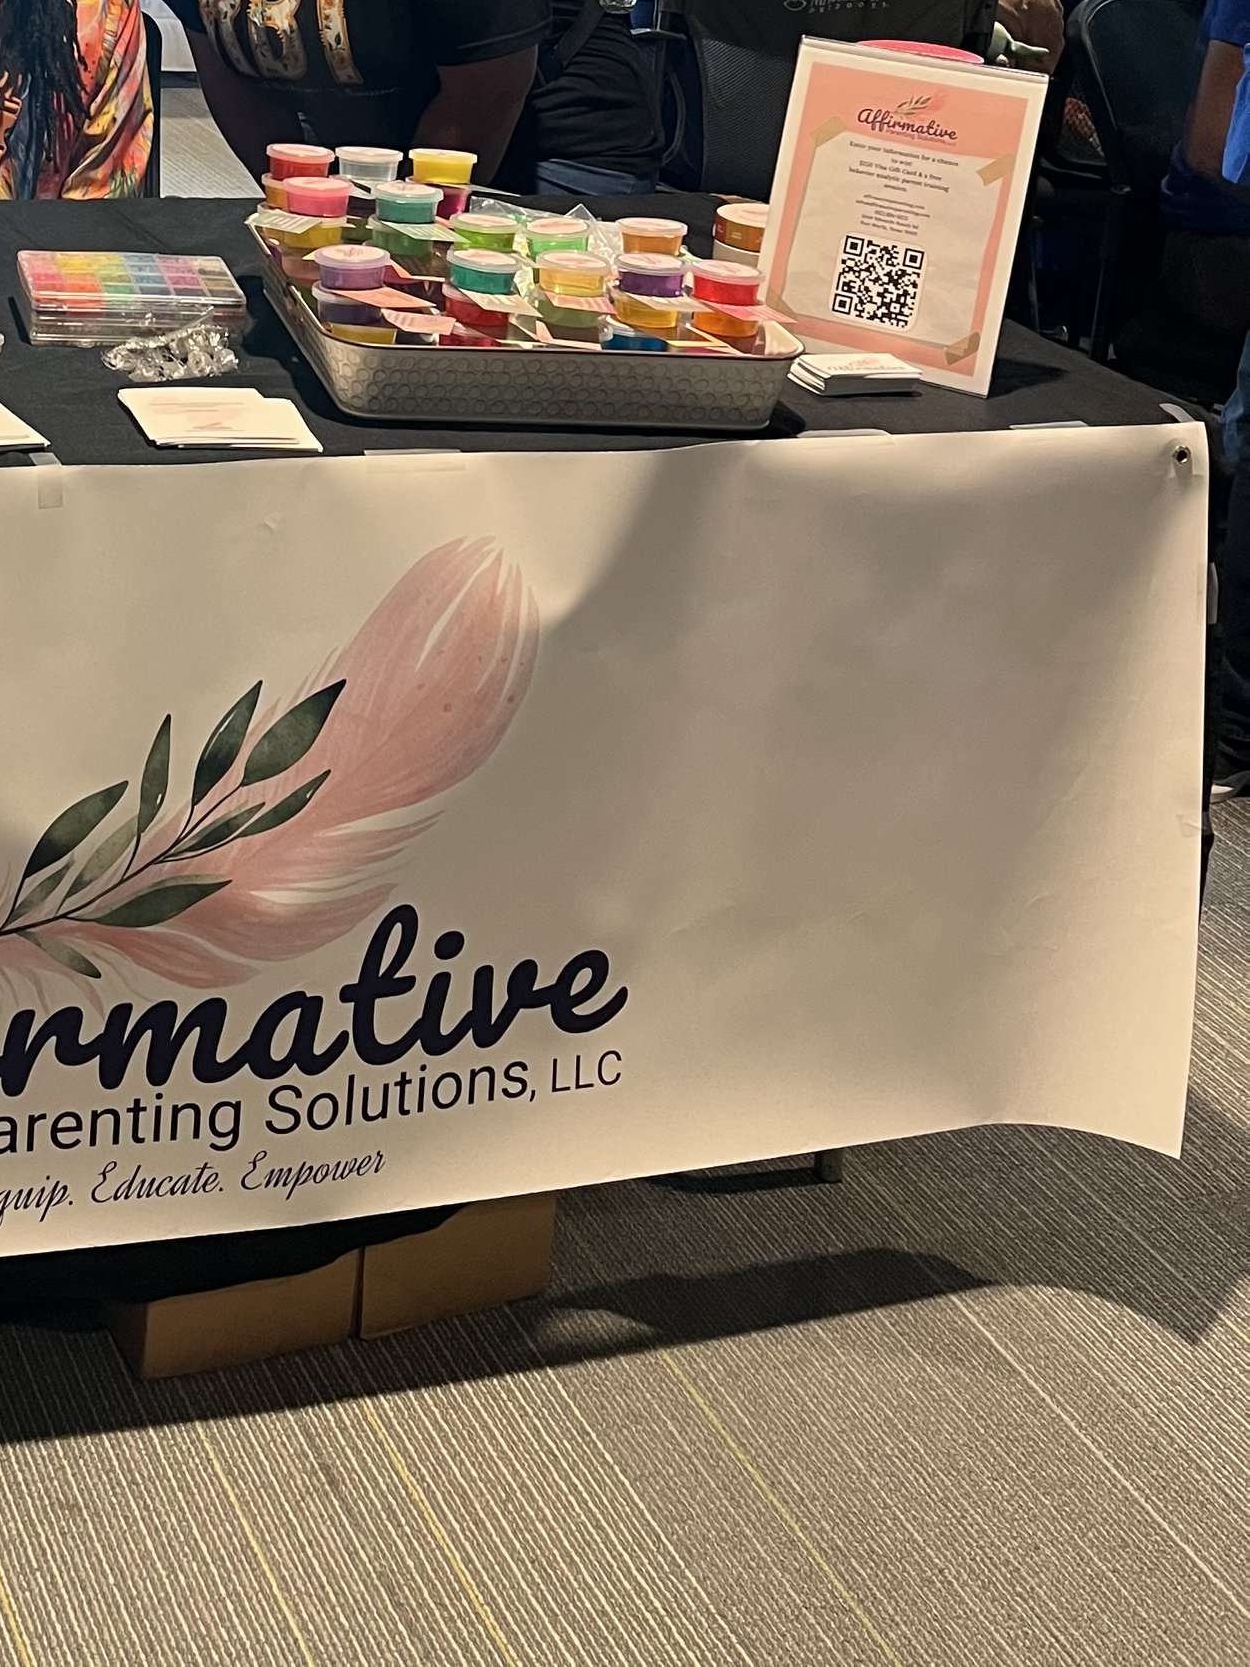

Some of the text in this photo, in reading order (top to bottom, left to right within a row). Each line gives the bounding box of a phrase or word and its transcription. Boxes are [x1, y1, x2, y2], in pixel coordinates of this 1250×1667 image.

[857, 108, 959, 141] Affirmative
[883, 147, 920, 160] information
[265, 1060, 537, 1136] Solutions,
[551, 1050, 623, 1094] LLC
[89, 1159, 225, 1206] Educate.
[240, 1146, 388, 1196] Empower
